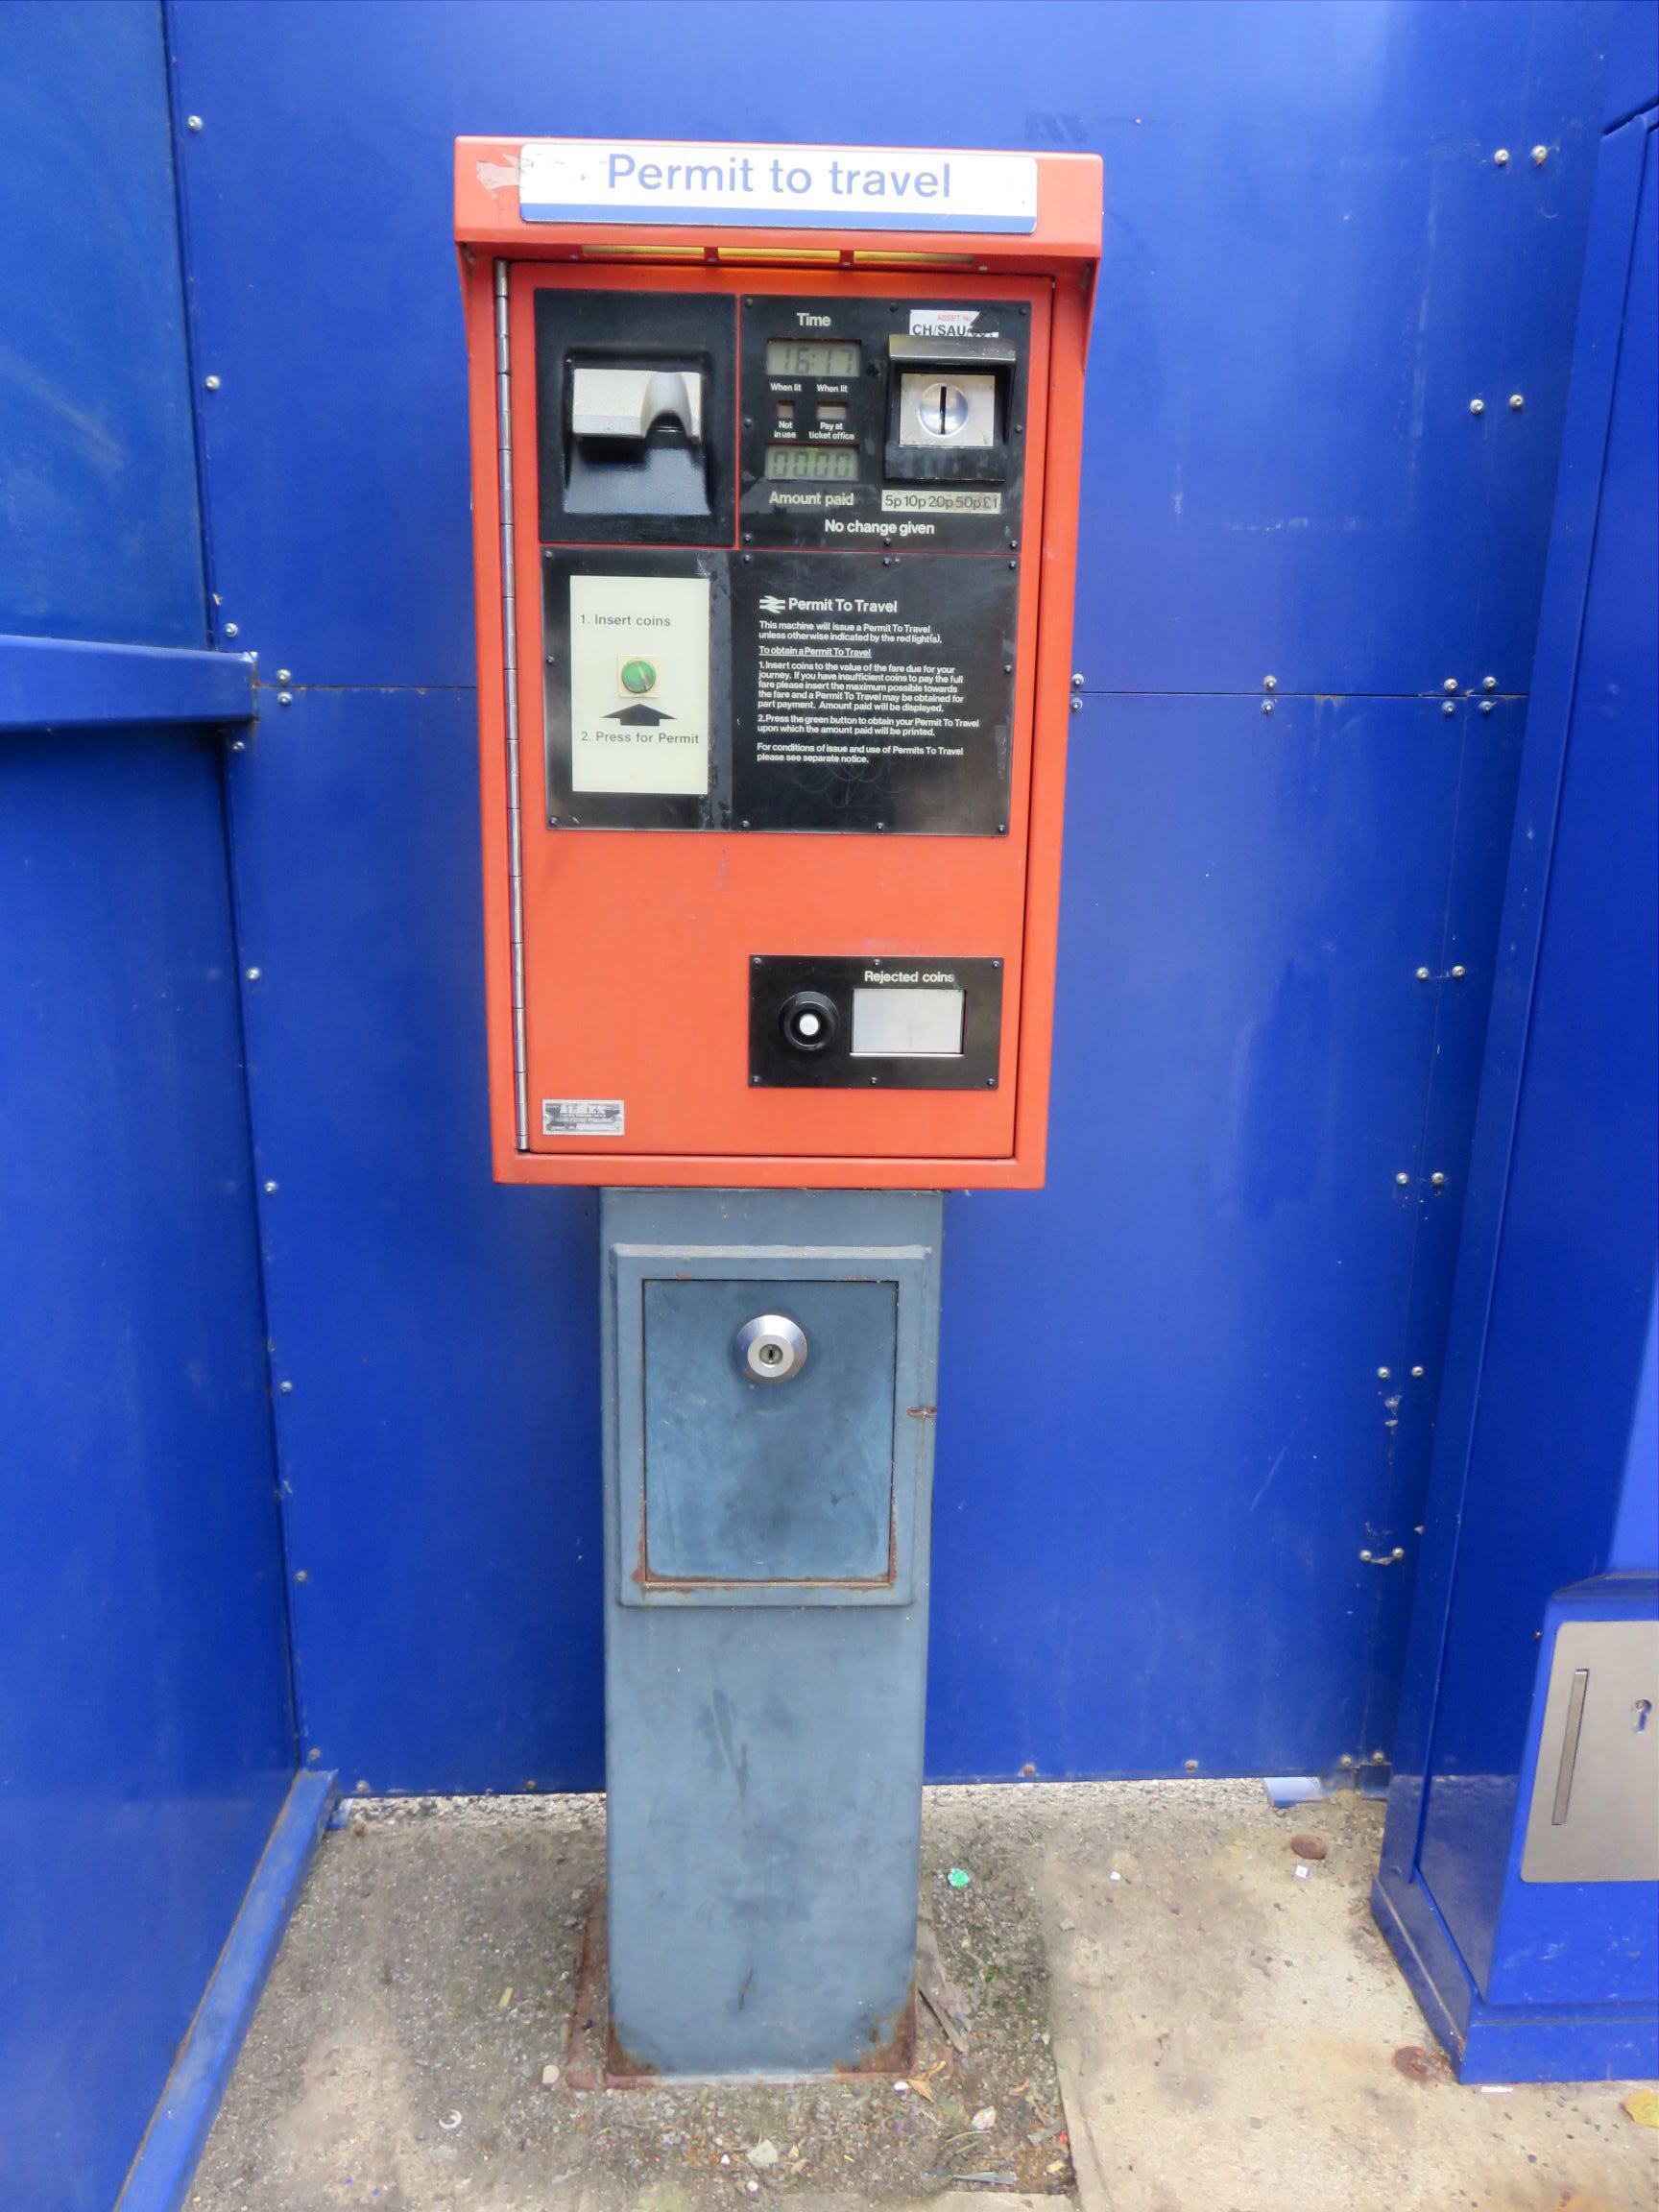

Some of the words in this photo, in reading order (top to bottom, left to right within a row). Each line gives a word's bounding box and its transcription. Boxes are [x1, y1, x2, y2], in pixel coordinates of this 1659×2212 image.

[607, 153, 753, 193] Permit
[771, 159, 812, 195] to
[829, 160, 952, 199] travel
[797, 313, 831, 326] Time
[770, 383, 793, 392] When
[817, 384, 838, 393] When
[820, 422, 833, 431] Pay
[808, 431, 831, 440] ticket
[769, 492, 821, 505] Amount
[825, 492, 854, 507] paid
[885, 495, 902, 507] 5p
[904, 495, 926, 508] 10p
[928, 495, 953, 509] 20p
[955, 496, 981, 509] 50p
[825, 519, 844, 532] No
[847, 520, 898, 537] change
[900, 522, 934, 537] given
[789, 597, 833, 611] Permit
[835, 599, 853, 612] To
[854, 600, 898, 613] Travel
[580, 614, 590, 624] 1.
[594, 613, 631, 625] Insert
[637, 615, 671, 627] coins
[759, 620, 777, 629] This
[832, 622, 854, 631] issue
[863, 623, 891, 632] Permit
[892, 624, 903, 633] To
[758, 631, 786, 639] unless
[830, 633, 869, 641] indicated
[870, 634, 880, 643] by
[912, 634, 942, 644] light(s).
[771, 646, 797, 655] obtain
[845, 648, 871, 657] Travel
[791, 661, 814, 670] coins
[874, 663, 887, 672] the
[906, 664, 922, 673] due
[758, 671, 791, 680] journey.
[777, 681, 804, 689] please
[846, 683, 886, 691] maximum
[888, 684, 923, 692] possible
[924, 685, 958, 693] towards
[815, 691, 843, 700] Permit
[855, 692, 881, 701] Travel
[757, 700, 776, 709] part
[777, 701, 815, 709] payment.
[854, 702, 872, 711] paid
[902, 704, 944, 713] displayed.
[790, 714, 804, 723] the
[854, 727, 873, 735] paid
[902, 728, 935, 736] printed.
[581, 732, 591, 742] 2.
[596, 732, 631, 742] Press
[637, 732, 654, 743] for
[659, 733, 699, 744] Permit
[773, 743, 814, 752] conditions
[827, 744, 848, 753] issue
[893, 746, 924, 755] Permits
[938, 747, 963, 756] Travel
[864, 970, 919, 984] Rejected
[922, 972, 955, 983] coins
